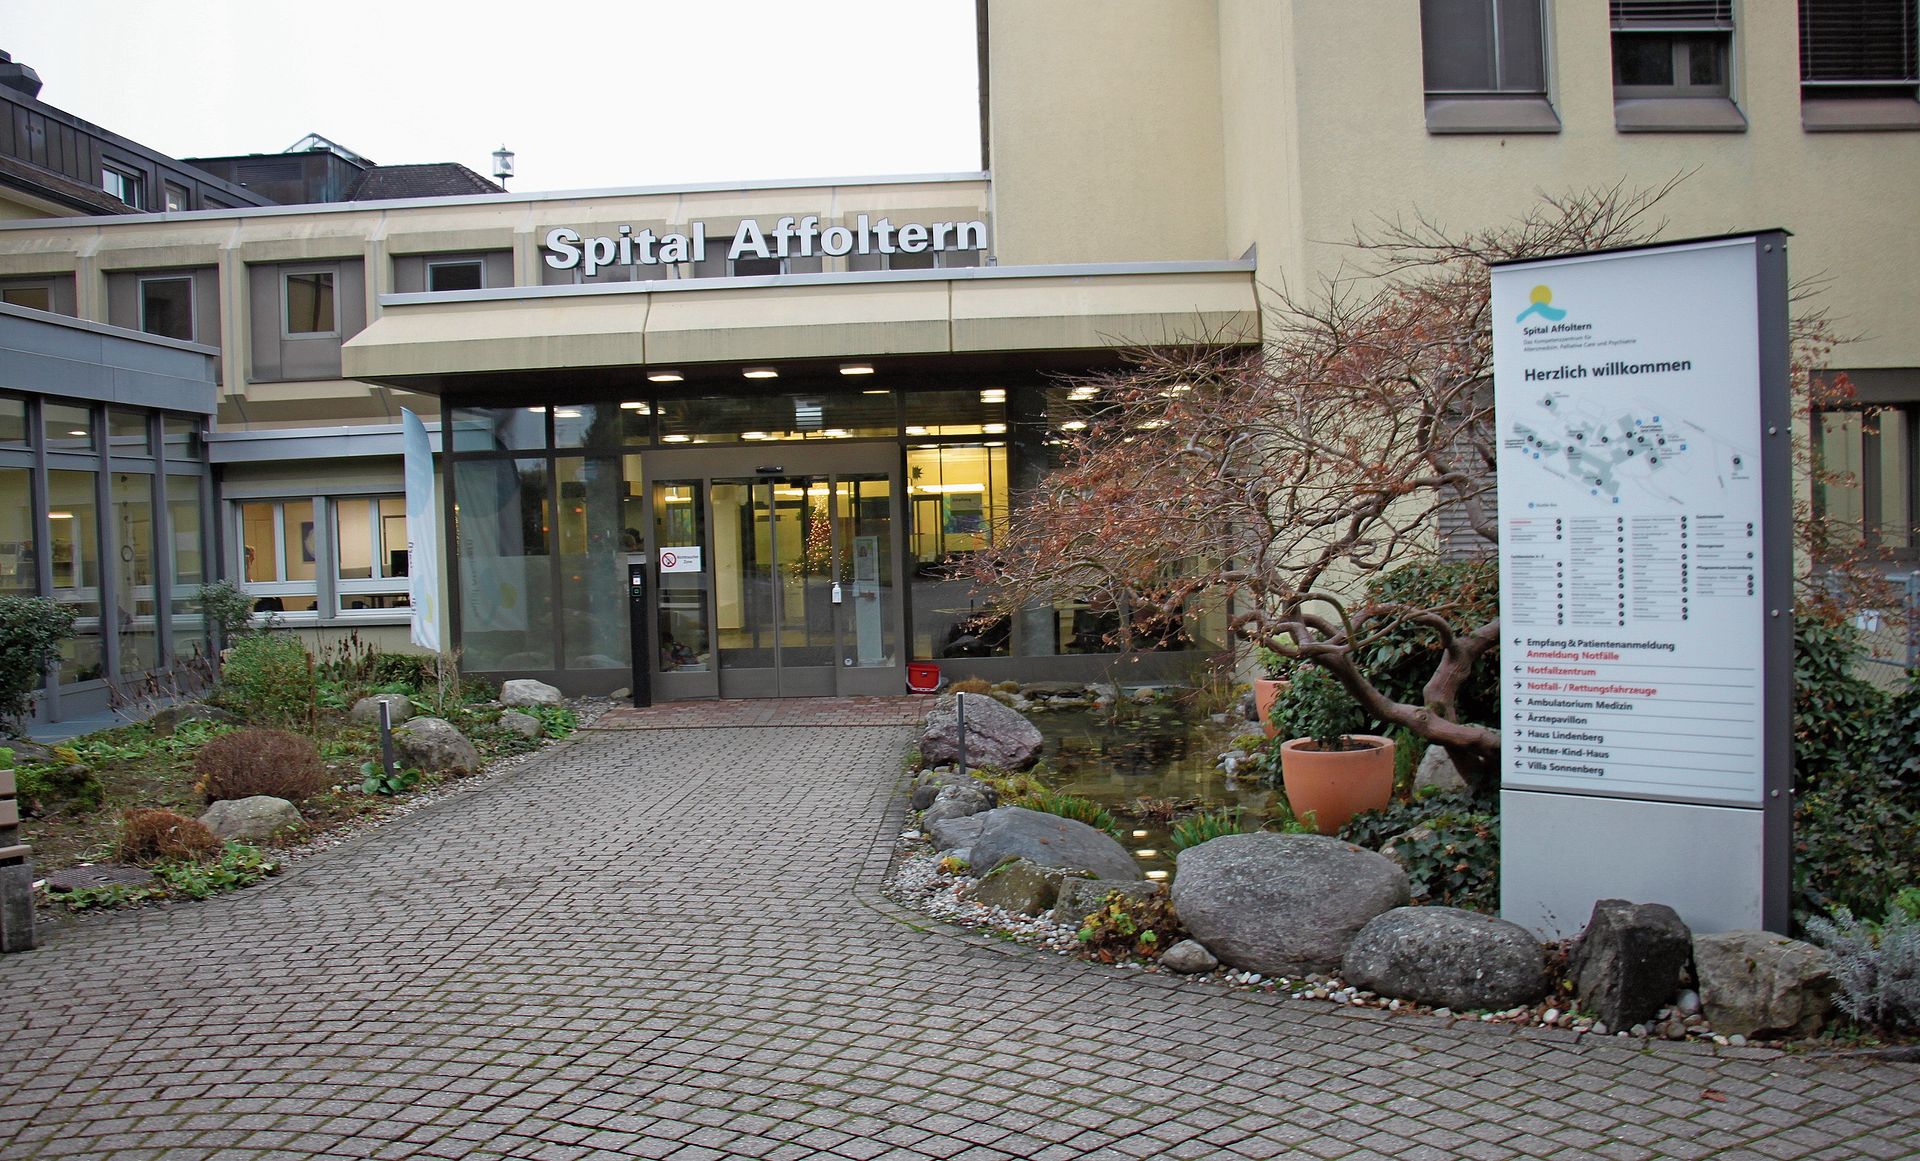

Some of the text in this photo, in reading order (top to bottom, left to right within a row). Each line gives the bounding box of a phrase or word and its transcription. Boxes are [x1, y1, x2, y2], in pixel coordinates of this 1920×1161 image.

[545, 213, 988, 277] Spital Affoltern
[1523, 322, 1592, 336] Spital Affoltern
[1525, 359, 1692, 381] Herzlich willkommen
[1527, 638, 1675, 651] Empfang & Patientenanmeldung
[1527, 650, 1619, 661] Anmeldung Notfälle
[1527, 666, 1596, 676] Notfallzentrum
[1527, 682, 1562, 691] Notfall-
[1569, 684, 1657, 696] Rettungsfahrzeuge
[1527, 698, 1633, 710] Ambulatorium Medizin
[1527, 712, 1587, 725] Ärztepavillon
[1527, 730, 1604, 743] Haus Lindenberg
[1527, 746, 1609, 759] Mutter-Kind-Haus
[1528, 762, 1604, 776] Villa Sonnenberg
